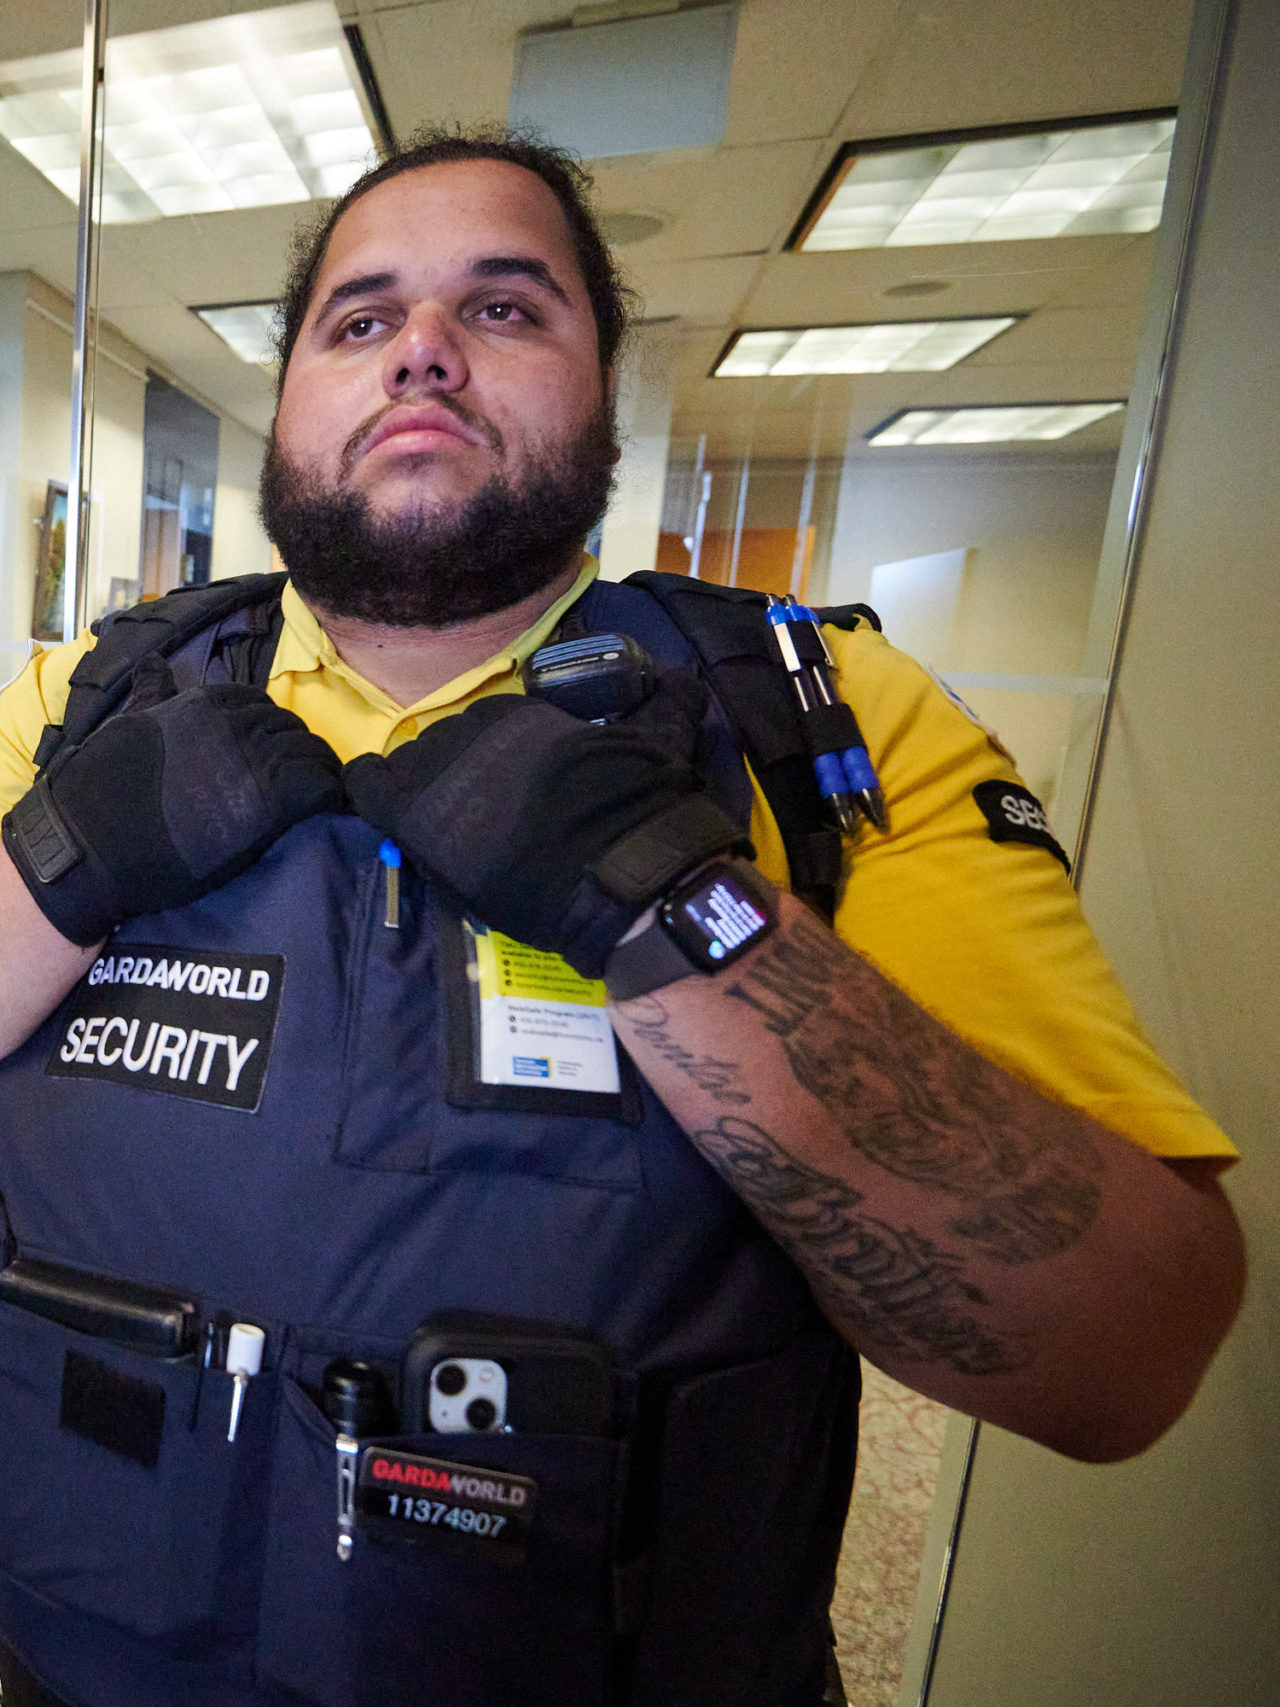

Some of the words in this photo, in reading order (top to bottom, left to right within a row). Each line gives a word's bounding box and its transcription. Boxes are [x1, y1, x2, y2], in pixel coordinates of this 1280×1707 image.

[88, 956, 270, 1001] GARDAWORLD
[60, 1017, 259, 1091] SECURITY
[372, 1459, 527, 1506] GARDAWORLD
[387, 1494, 507, 1537] 11374907
